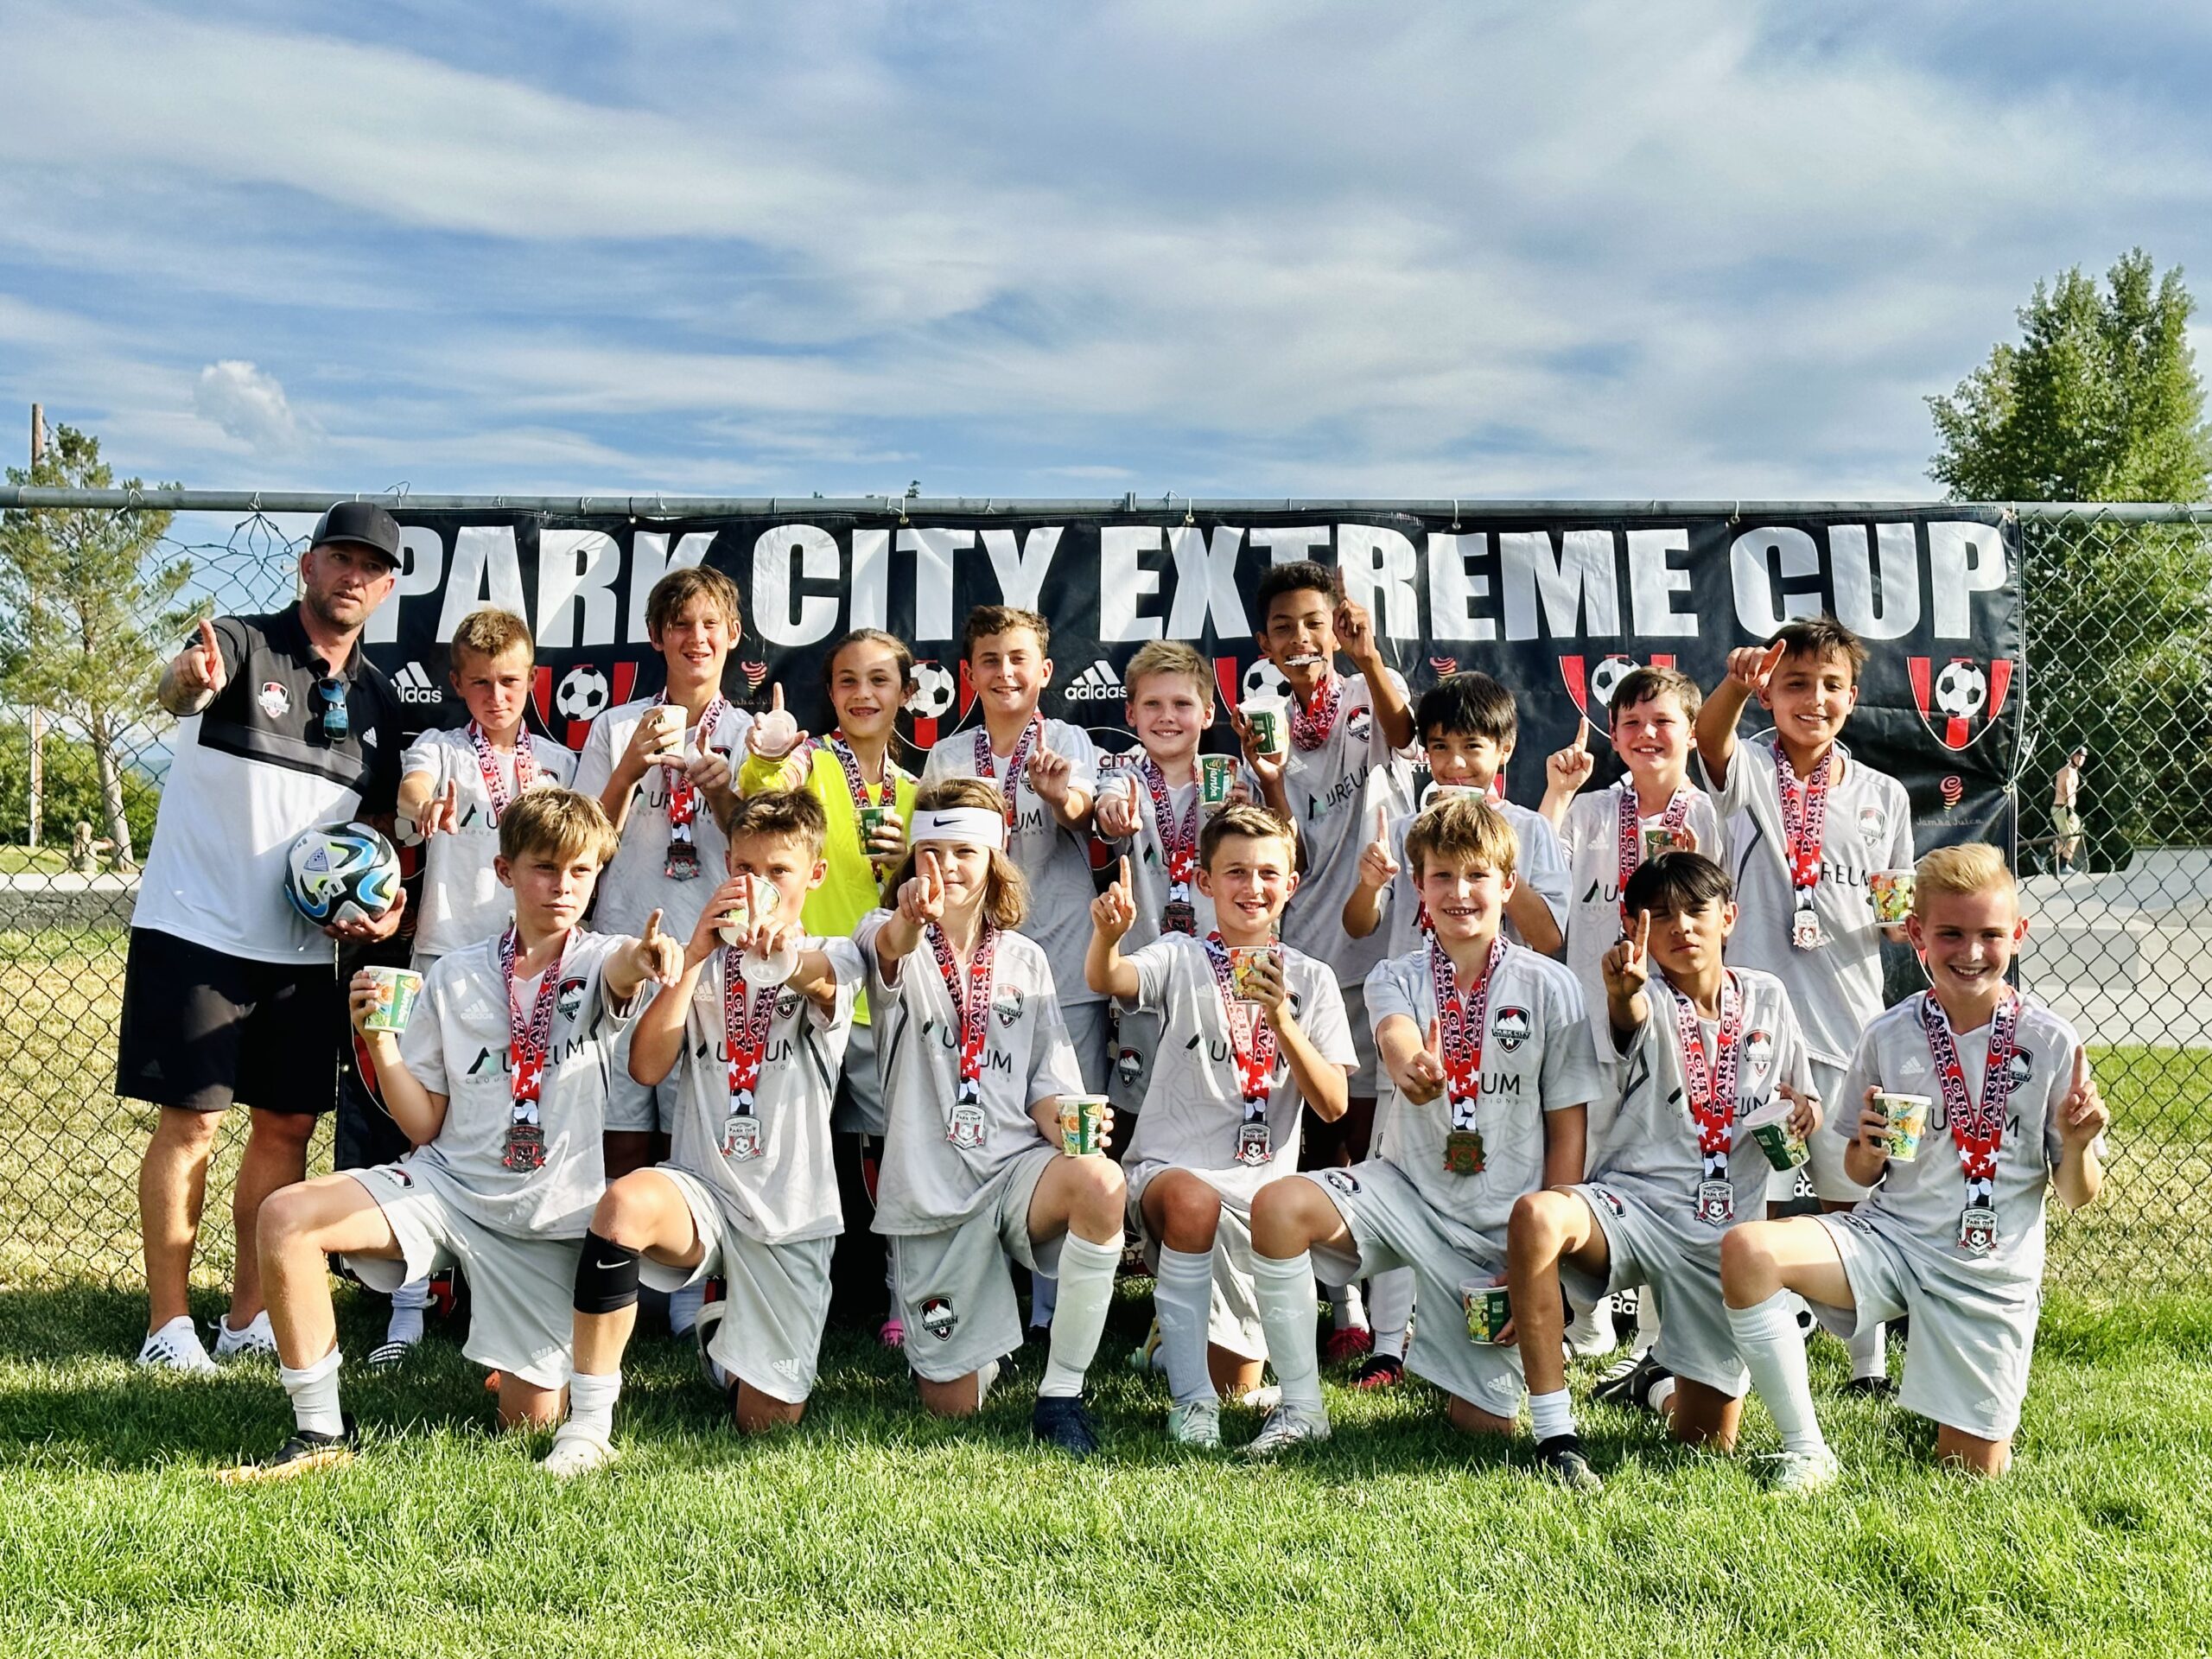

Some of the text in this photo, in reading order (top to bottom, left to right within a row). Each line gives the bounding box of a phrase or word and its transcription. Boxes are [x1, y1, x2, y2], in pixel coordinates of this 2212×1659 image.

[363, 521, 2007, 648] PARK CITY EXTREME CUP
[706, 700, 724, 733] PAR
[1065, 683, 1128, 701] adidas
[1098, 754, 1139, 768] CITY
[1307, 766, 1370, 821] AUREU
[1801, 792, 1819, 856] PARK
[1916, 816, 1985, 827] Jamba Juice
[1441, 951, 1458, 1002] ARK
[524, 991, 547, 1065] PARK
[726, 1005, 734, 1042] CUP
[733, 992, 747, 1051] CITY
[968, 974, 985, 1044] PARK
[1460, 988, 1480, 1063] PARK
[1713, 1043, 1732, 1117] PARK
[1726, 1026, 1740, 1107] EXTREME
[1928, 995, 1977, 1139] PARK CITY
[1978, 998, 2008, 1141] PARK CITY
[1993, 1044, 2012, 1130] EXTREME
[1481, 1096, 1520, 1105] TIONS
[1946, 1092, 1961, 1128] CUP
